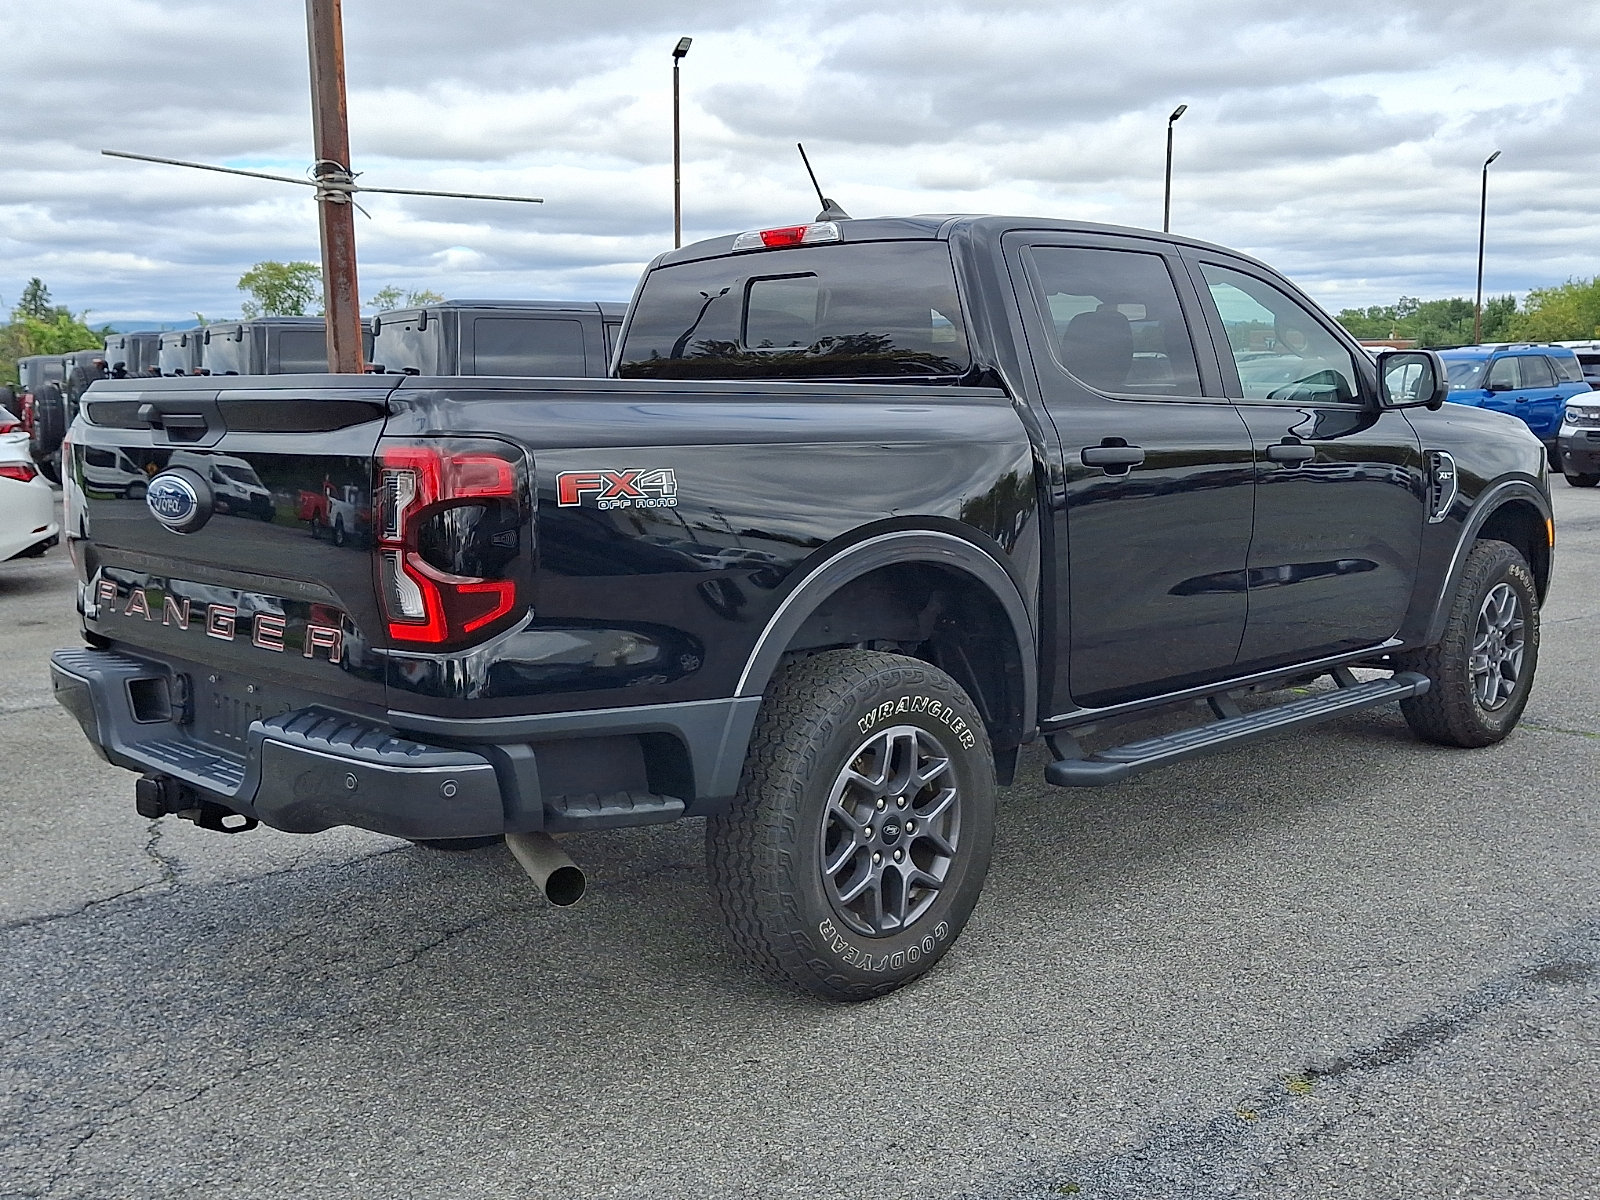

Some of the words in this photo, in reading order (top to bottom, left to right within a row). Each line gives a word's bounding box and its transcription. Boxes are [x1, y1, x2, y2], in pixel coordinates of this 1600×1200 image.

[150, 485, 182, 513] Ford
[556, 468, 677, 507] FX4
[598, 500, 631, 510] OFF
[635, 498, 677, 508] ROAD
[97, 580, 342, 664] RANGER
[858, 696, 976, 750] WRANGLER
[819, 918, 949, 972] GOODYEAR
